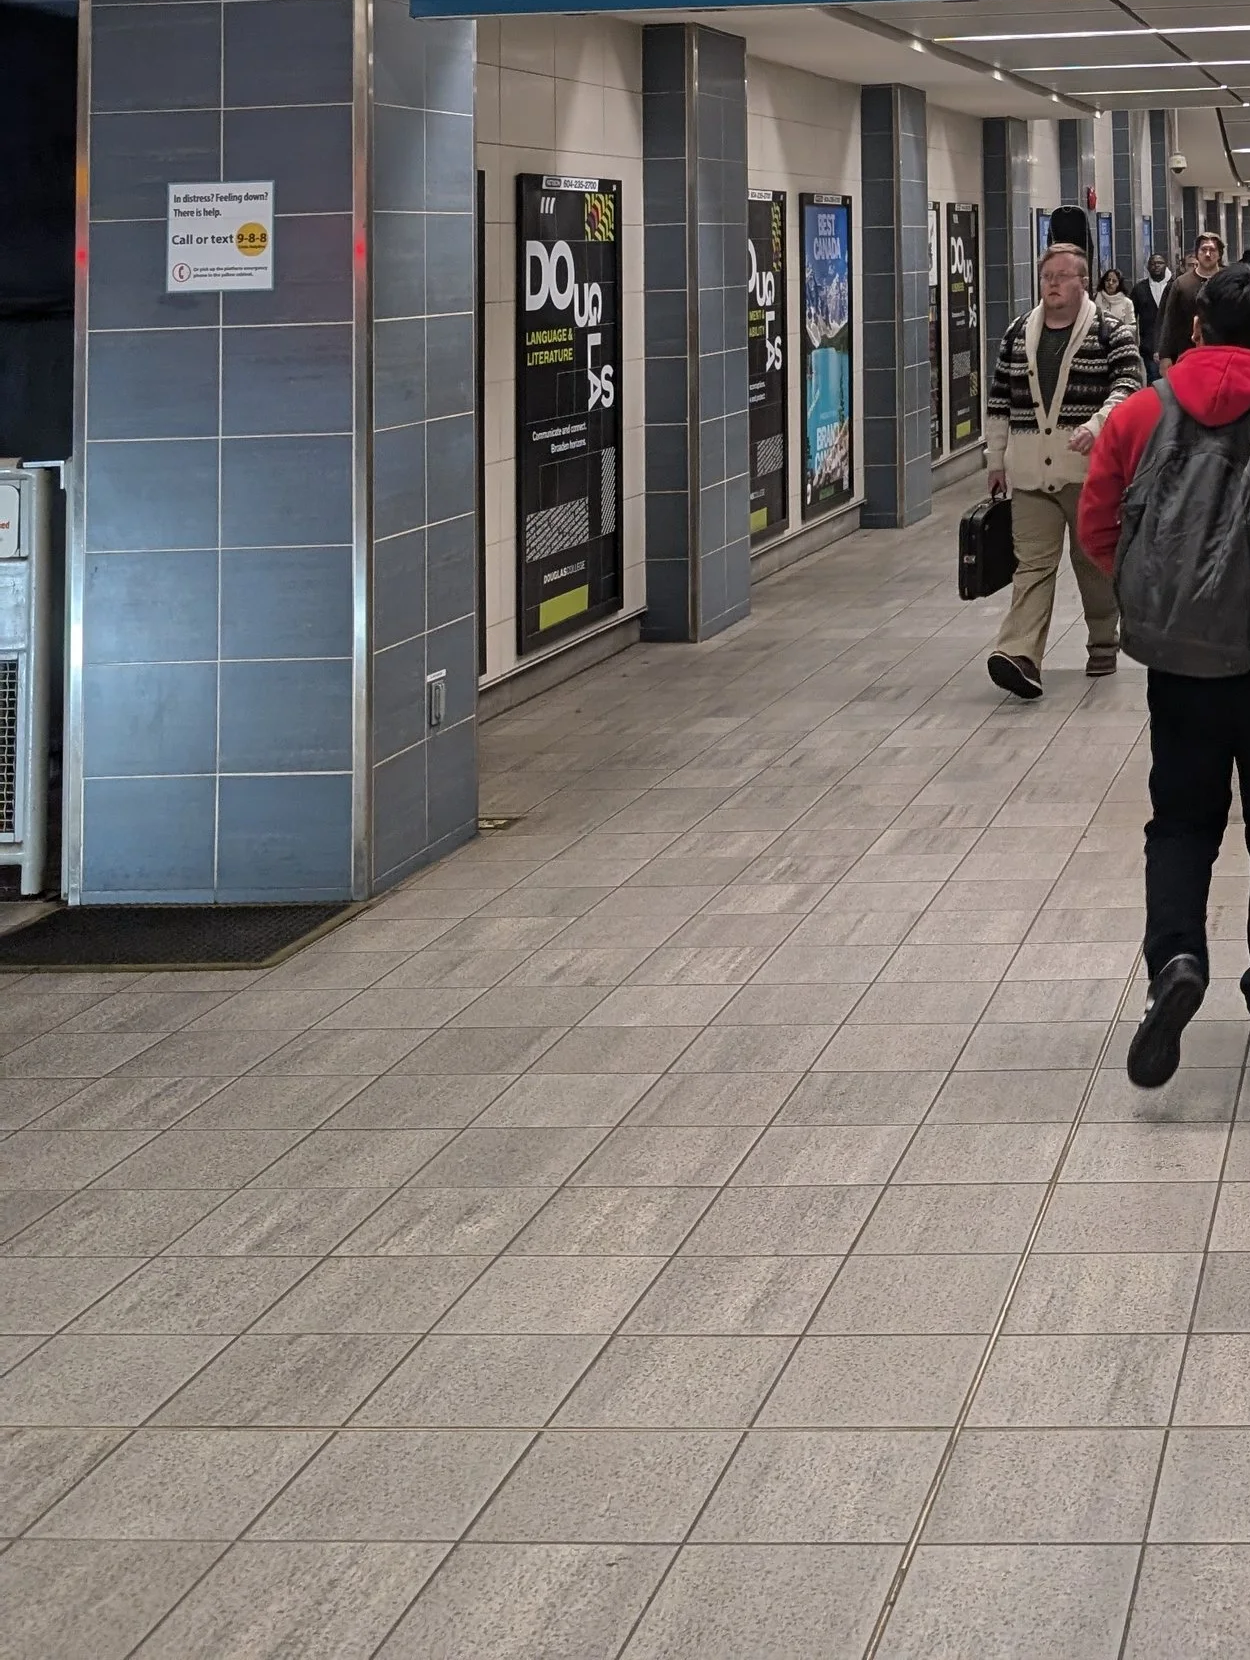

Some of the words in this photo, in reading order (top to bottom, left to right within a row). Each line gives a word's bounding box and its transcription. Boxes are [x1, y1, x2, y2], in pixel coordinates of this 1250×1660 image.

[182, 193, 214, 203] distress?
[215, 192, 243, 203] Feeling
[244, 191, 268, 201] down?
[173, 208, 195, 217] There
[195, 208, 202, 216] is
[203, 207, 222, 218] help.
[817, 213, 836, 236] BEST
[172, 234, 193, 245] Call
[196, 236, 209, 244] or
[211, 234, 234, 244] text
[237, 233, 267, 244] 9-8-8
[813, 237, 842, 260] CANADA
[525, 330, 566, 345] LANGUAGE
[567, 328, 573, 340] &
[527, 348, 573, 366] LITERATURE
